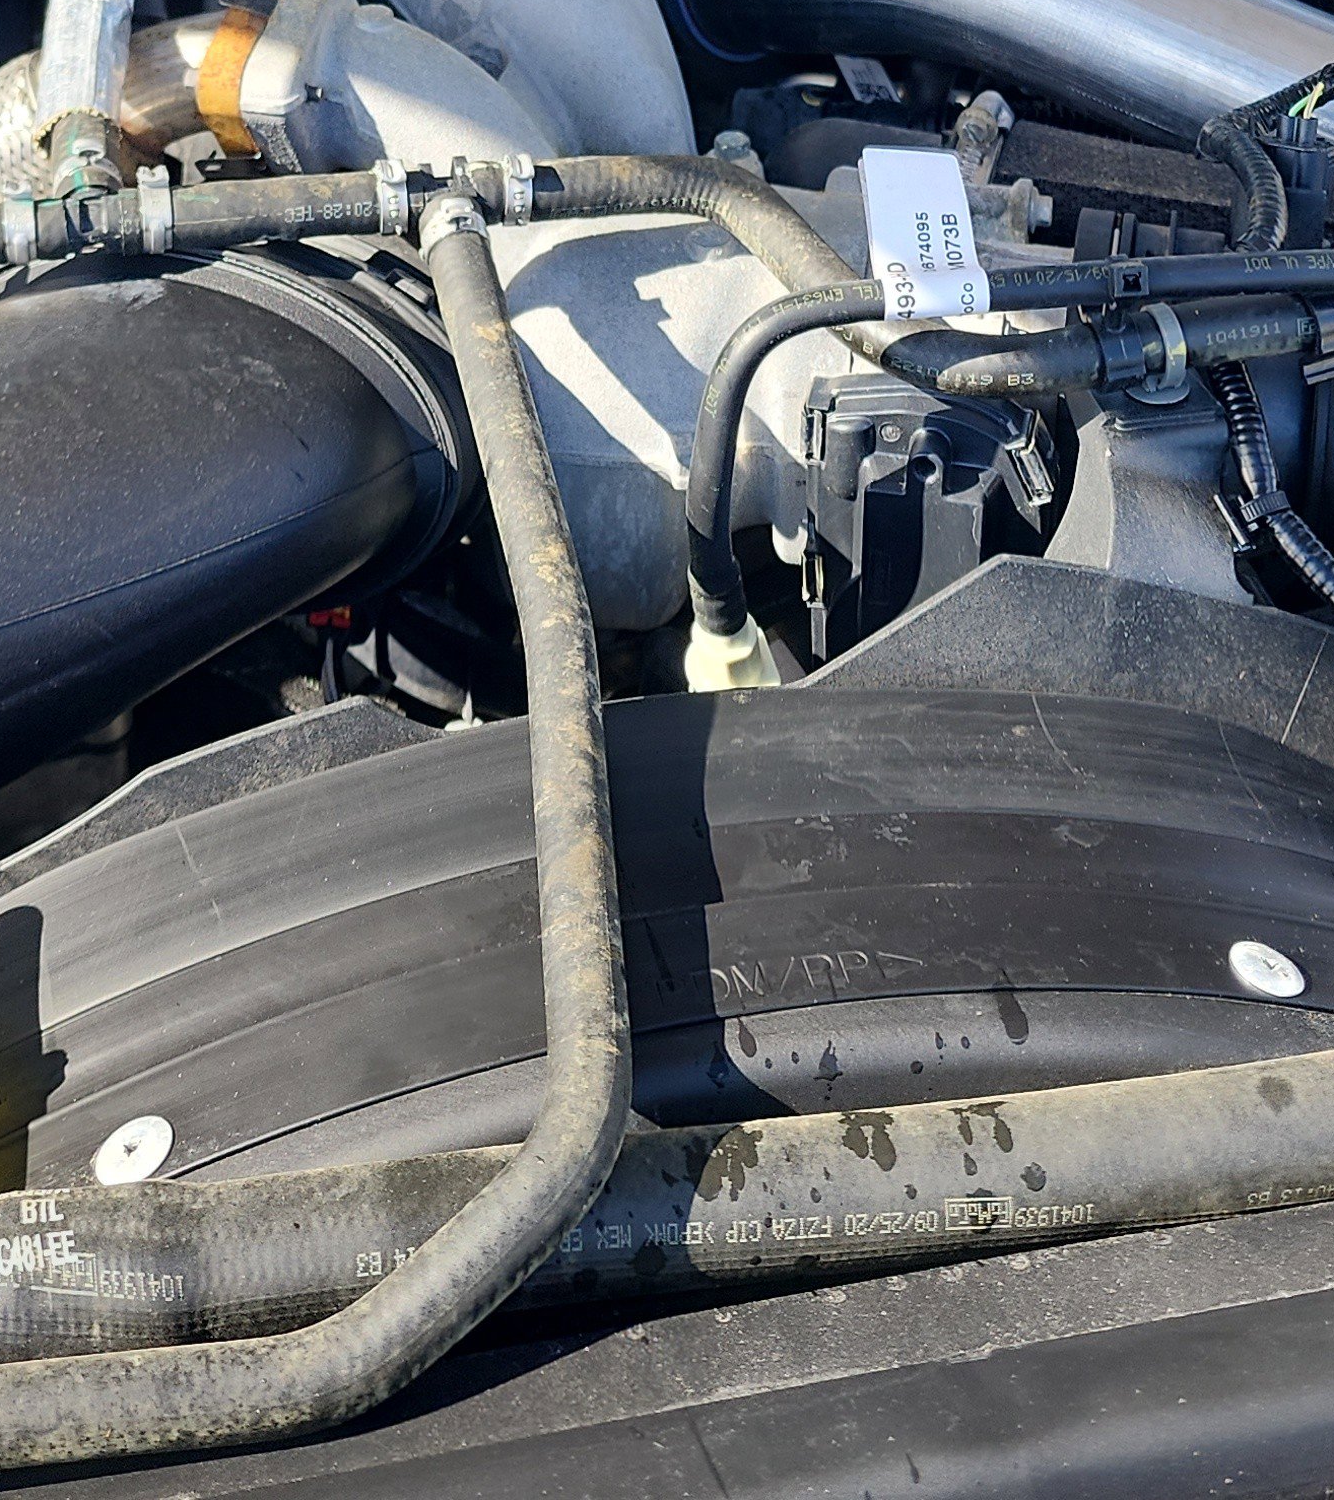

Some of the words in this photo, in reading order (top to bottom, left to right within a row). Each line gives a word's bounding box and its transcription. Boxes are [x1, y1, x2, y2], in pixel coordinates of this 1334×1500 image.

[1244, 257, 1271, 272] DOT
[1205, 321, 1282, 346] 1041911
[1007, 372, 1036, 387] B3
[21, 1199, 66, 1225] BTL
[844, 1208, 938, 1236] 09/25/20
[1015, 1202, 1095, 1229] 1041939
[597, 1229, 632, 1249] MEX
